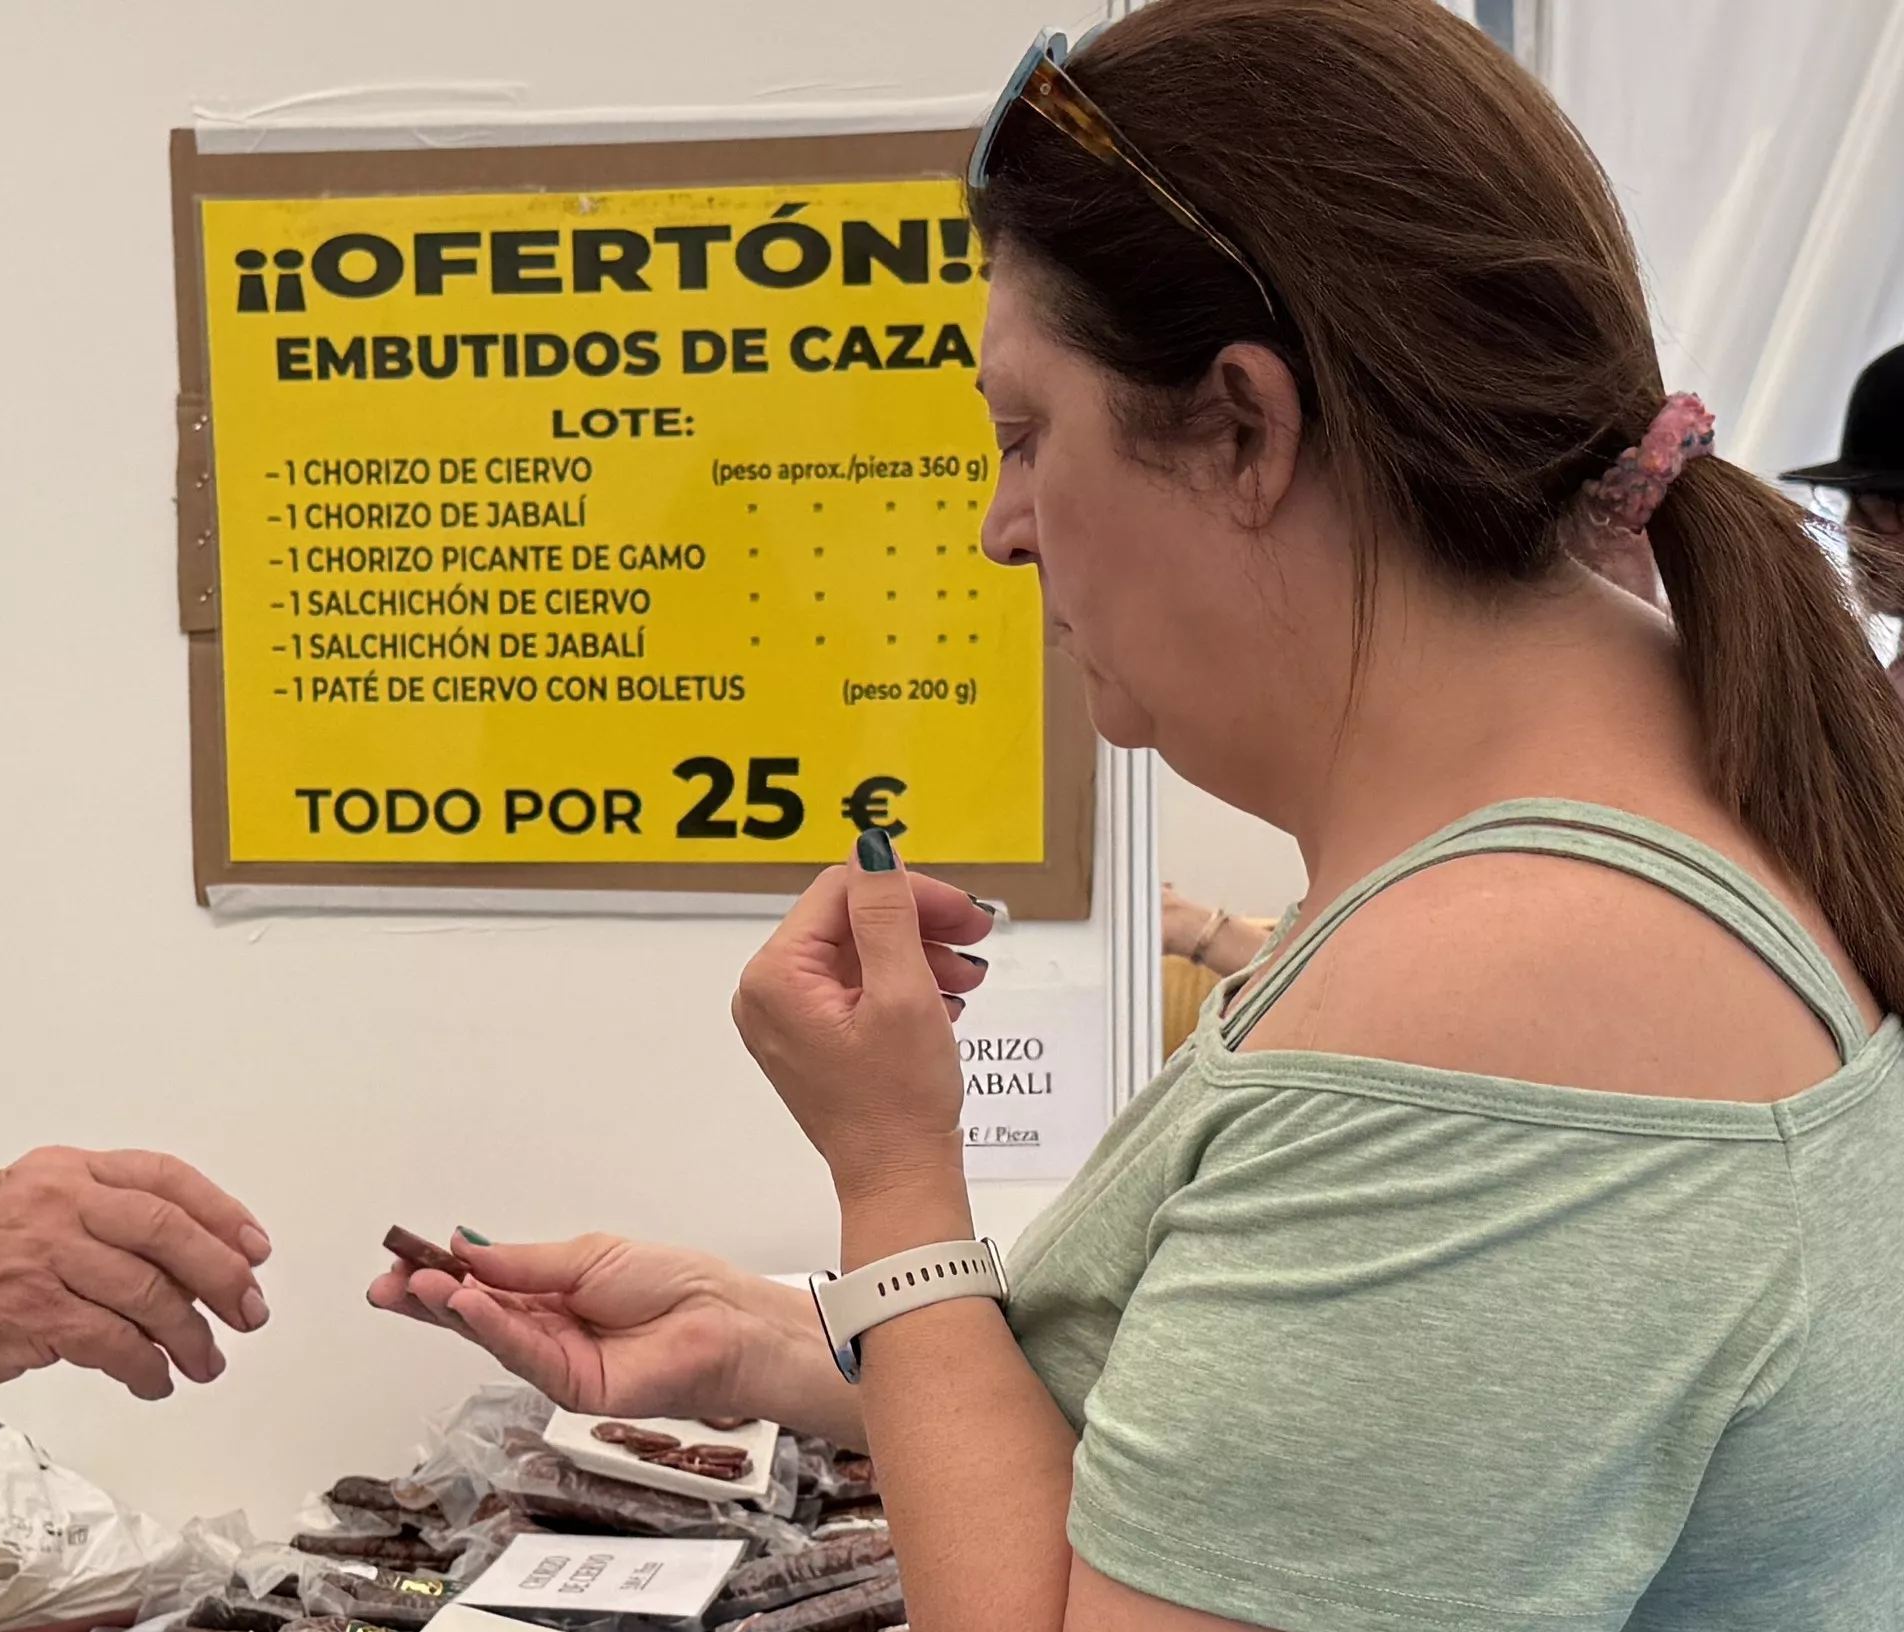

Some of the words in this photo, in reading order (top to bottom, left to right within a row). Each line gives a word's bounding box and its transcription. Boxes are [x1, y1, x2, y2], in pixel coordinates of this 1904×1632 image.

[235, 203, 990, 313] ¡¡OFERTÓN!
[276, 330, 661, 380] EMBUTIDOS
[682, 328, 769, 374] DE
[790, 324, 977, 372] CAZA
[553, 408, 695, 438] LOTE:
[304, 459, 430, 485] CHORIZO
[439, 459, 478, 484] DE
[486, 457, 592, 483] CIERVO
[712, 459, 771, 486] (peso
[920, 456, 959, 477] 360
[966, 455, 989, 482] g)
[306, 503, 431, 529] CHORIZO
[441, 503, 478, 528] DE
[487, 495, 586, 528] JABALÍ
[307, 546, 432, 573] CHORIZO
[443, 546, 562, 572] PICANTE
[573, 546, 609, 571] DE
[620, 544, 705, 570] GAMO
[308, 583, 489, 616] SALCHICHÓN
[499, 589, 536, 615] DE
[545, 588, 651, 615] CIERVO
[310, 627, 489, 659] SALCHICHÓN
[499, 633, 537, 658] DE
[546, 626, 646, 658] JABALÍ
[312, 670, 379, 702] PATÉ
[388, 676, 424, 701] DE
[433, 675, 537, 701] CIERVO
[546, 675, 607, 701] CON
[617, 674, 745, 701] BOLETUS
[843, 679, 901, 705] (peso
[908, 679, 948, 699] 200
[955, 679, 977, 705] g)
[295, 788, 482, 835] TODO
[504, 788, 642, 835] POR
[672, 756, 806, 840] 25
[842, 776, 908, 838] €
[957, 1038, 1044, 1062] ORIZO
[966, 1072, 1052, 1095] ABALI
